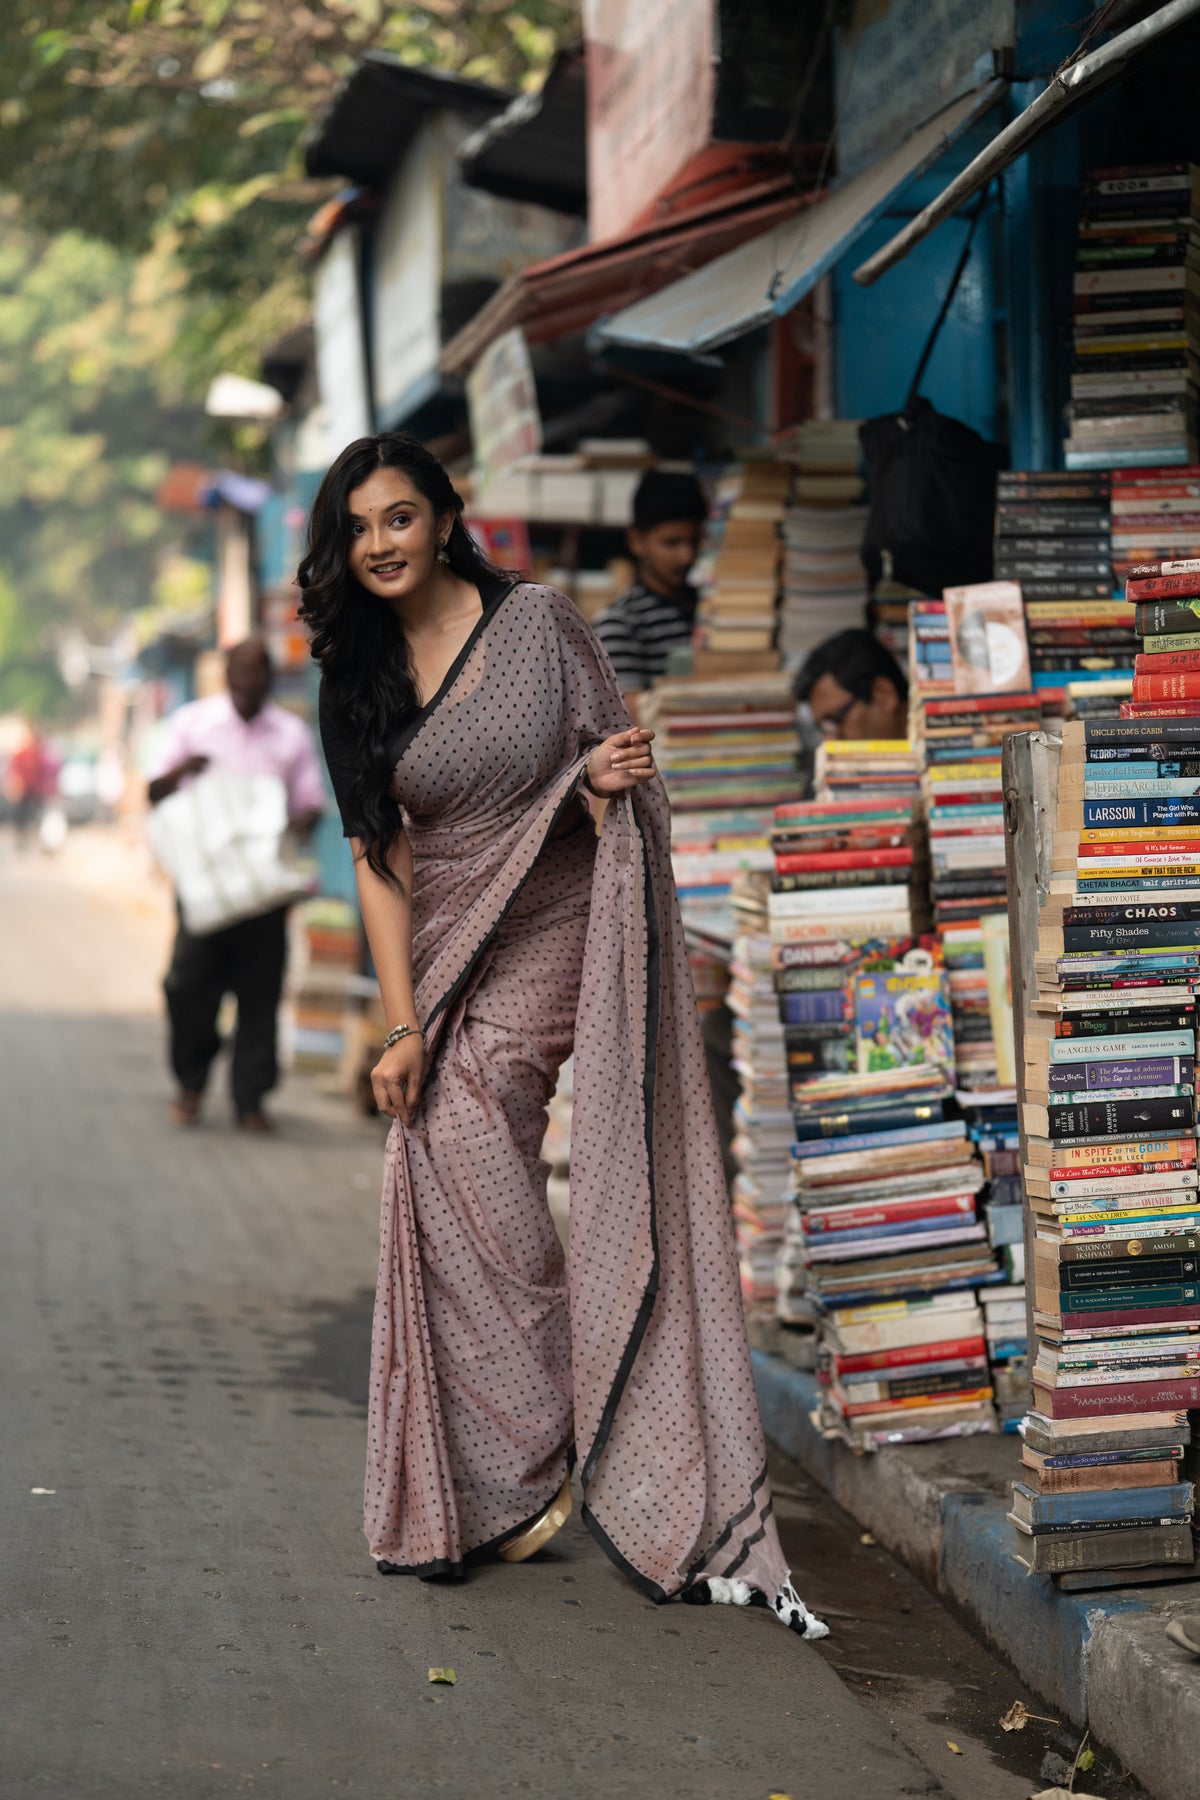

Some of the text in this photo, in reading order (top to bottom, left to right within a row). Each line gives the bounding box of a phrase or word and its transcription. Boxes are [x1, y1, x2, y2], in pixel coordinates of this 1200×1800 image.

[1090, 727, 1163, 737] UNCLE TOM'S CABIN
[1088, 768, 1112, 777] Twelve
[1128, 766, 1155, 776] Herrings
[1093, 780, 1173, 795] JEFFREY ARCHER
[1168, 804, 1180, 812] Girl
[1088, 806, 1136, 821] LARSSON
[1141, 867, 1153, 875] NOW
[1154, 867, 1166, 875] THAT
[1167, 866, 1186, 875] YOU'RE
[1078, 878, 1200, 889] CHETAN BHAGAT half girlfriend
[1096, 895, 1120, 903] RODDY
[1120, 894, 1141, 902] DOYLE
[1070, 911, 1092, 919] JAMES
[1125, 907, 1177, 919] CHAOS
[786, 925, 827, 939] SACHIN
[1090, 927, 1150, 939] Fifty Shades
[1106, 936, 1136, 945] of Grey
[783, 949, 810, 965] DAN
[1080, 1020, 1108, 1031] Dancing
[1066, 1045, 1101, 1055] ANGEL'S
[1102, 1043, 1127, 1052] GAME
[1051, 1073, 1085, 1082] Enid Blyton
[1132, 1073, 1163, 1081] adventure
[1086, 1133, 1126, 1143] AUTOBIOGRAPHY
[1071, 1149, 1081, 1158] IN
[1084, 1147, 1113, 1158] SPITE
[1139, 1141, 1170, 1155] GODS
[1091, 1155, 1123, 1164] EDWARD
[1052, 1170, 1065, 1178] This
[1066, 1170, 1081, 1178] Love
[1082, 1168, 1095, 1176] that
[1143, 1162, 1169, 1172] RAVINDER
[1170, 1161, 1187, 1170] SINGH
[1091, 1185, 1114, 1194] Lessons
[1114, 1184, 1122, 1192] for
[1143, 1181, 1165, 1190] Century
[1141, 1196, 1174, 1206] ADVENTURE
[1088, 1212, 1110, 1221] NANCY
[1110, 1211, 1130, 1219] DREW
[1134, 1230, 1162, 1238] TOYLAND
[1076, 1243, 1176, 1252] SCION OF AMISH
[1076, 1250, 1114, 1259] IKSHVAKU
[1150, 1394, 1184, 1402] CANAVAN
[1053, 1459, 1071, 1467] TALES
[1080, 1454, 1119, 1464] SHAKESPEARE
